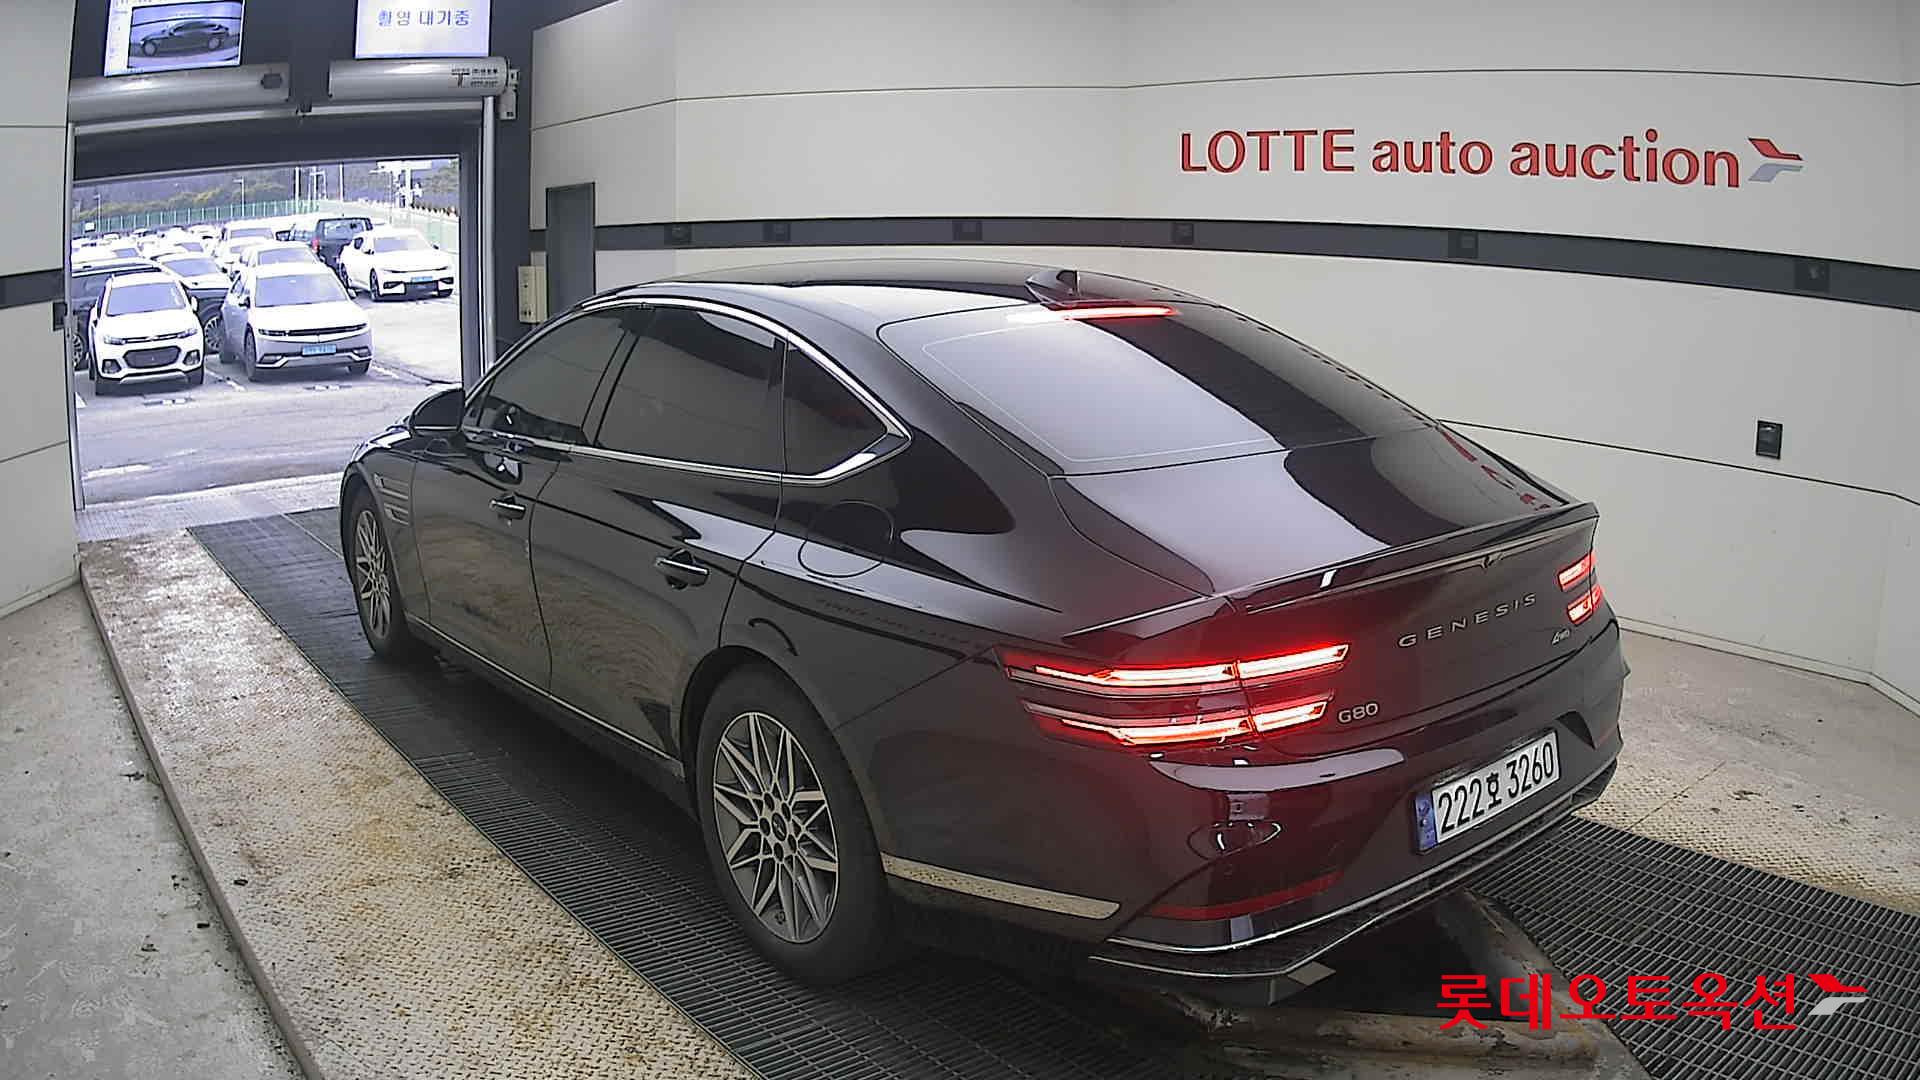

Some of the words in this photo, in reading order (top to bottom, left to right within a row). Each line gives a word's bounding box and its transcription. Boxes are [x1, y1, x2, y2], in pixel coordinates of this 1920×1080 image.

[419, 10, 470, 26] 대기중
[1181, 129, 1355, 173] LOTTE
[1372, 131, 1493, 175] auto
[1510, 129, 1740, 188] auction
[1398, 593, 1536, 648] GENESIS
[1337, 702, 1379, 724] G80
[1438, 772, 1503, 834] 222호
[1506, 742, 1554, 798] 3260
